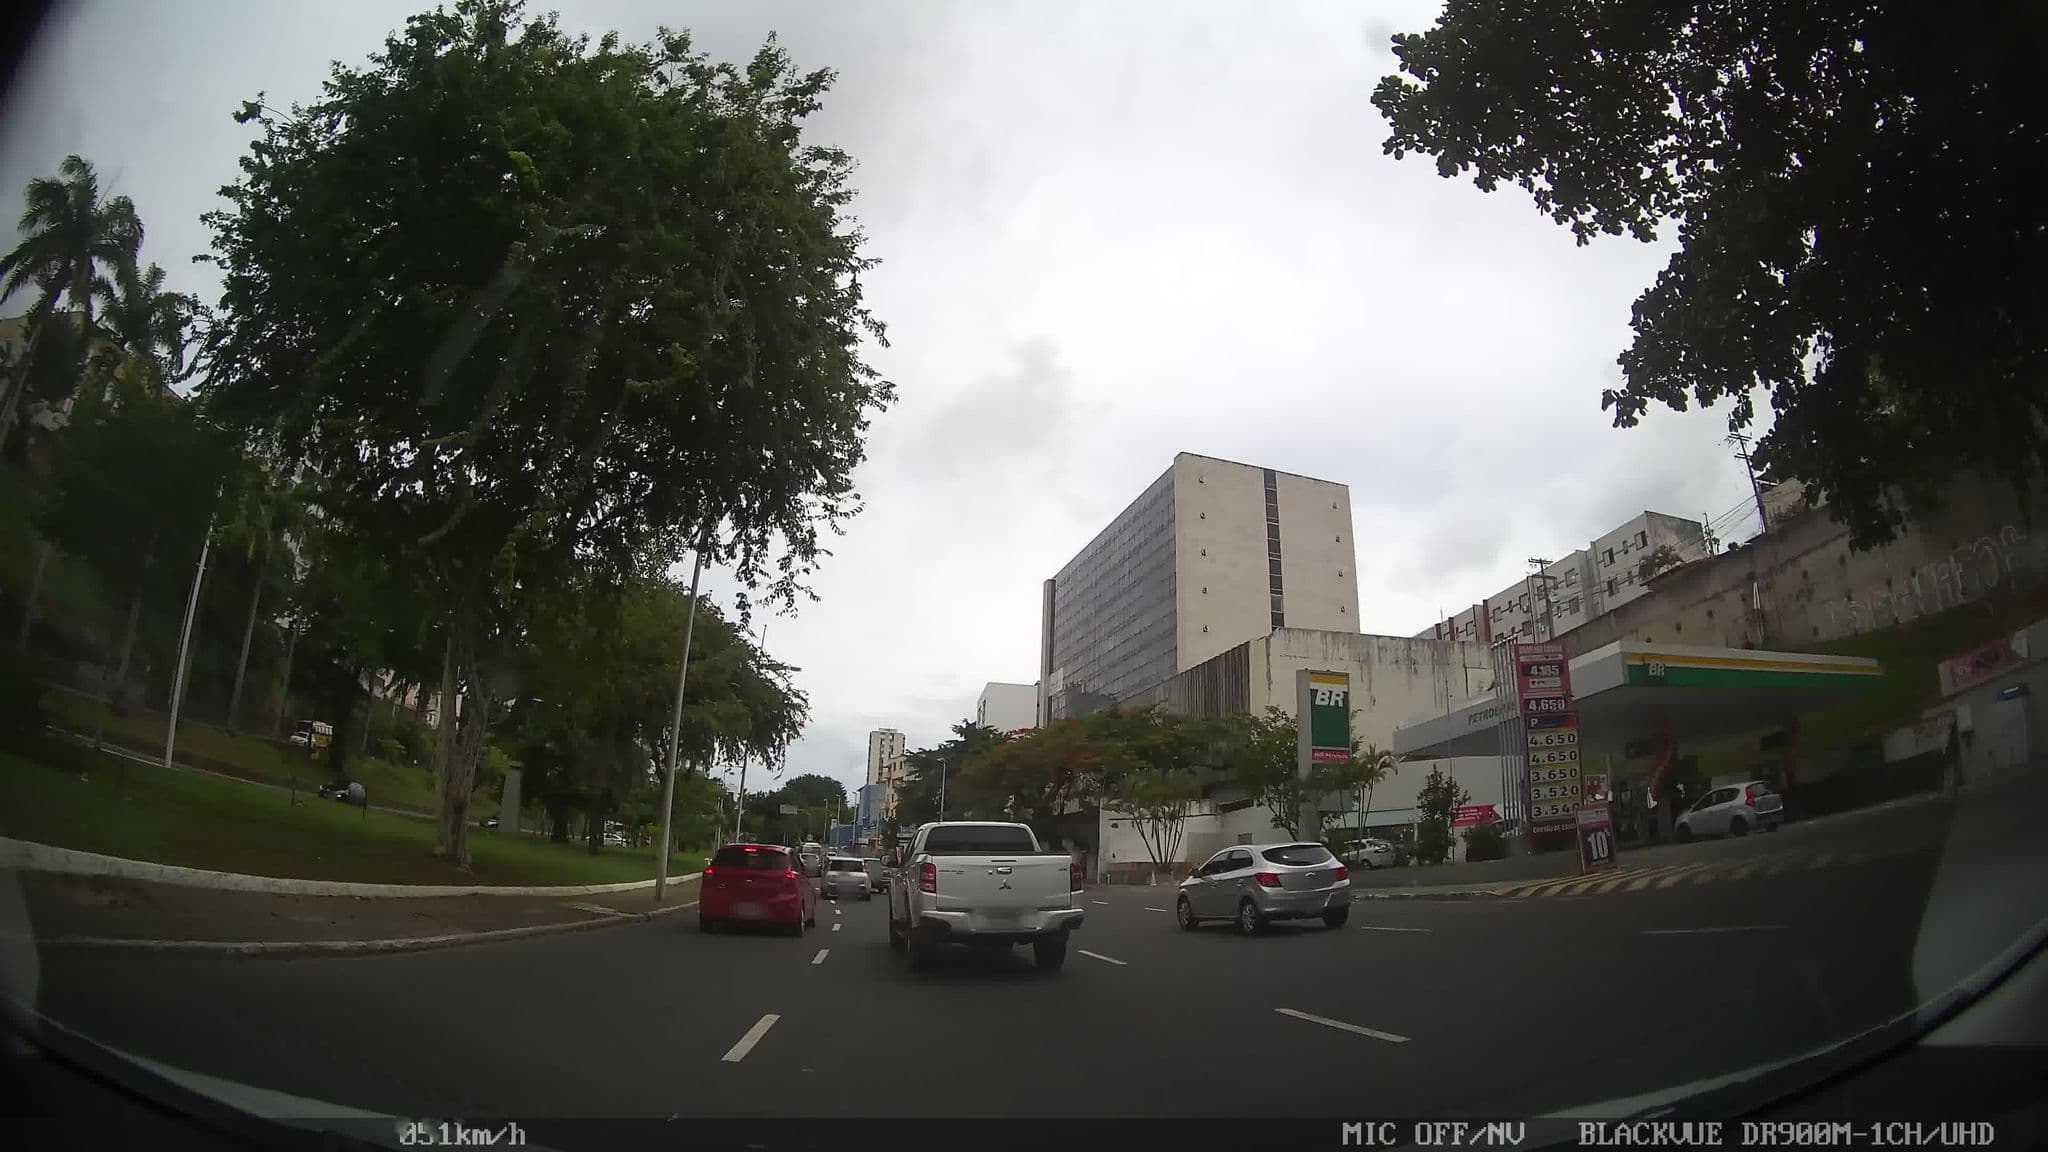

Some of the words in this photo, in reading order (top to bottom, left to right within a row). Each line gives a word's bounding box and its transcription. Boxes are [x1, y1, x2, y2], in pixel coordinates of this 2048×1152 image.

[1648, 664, 1665, 677] BR
[1315, 688, 1344, 707] BR
[1530, 733, 1576, 746] 4.650
[1532, 751, 1577, 763] 4.650
[1532, 768, 1577, 781] 3.650
